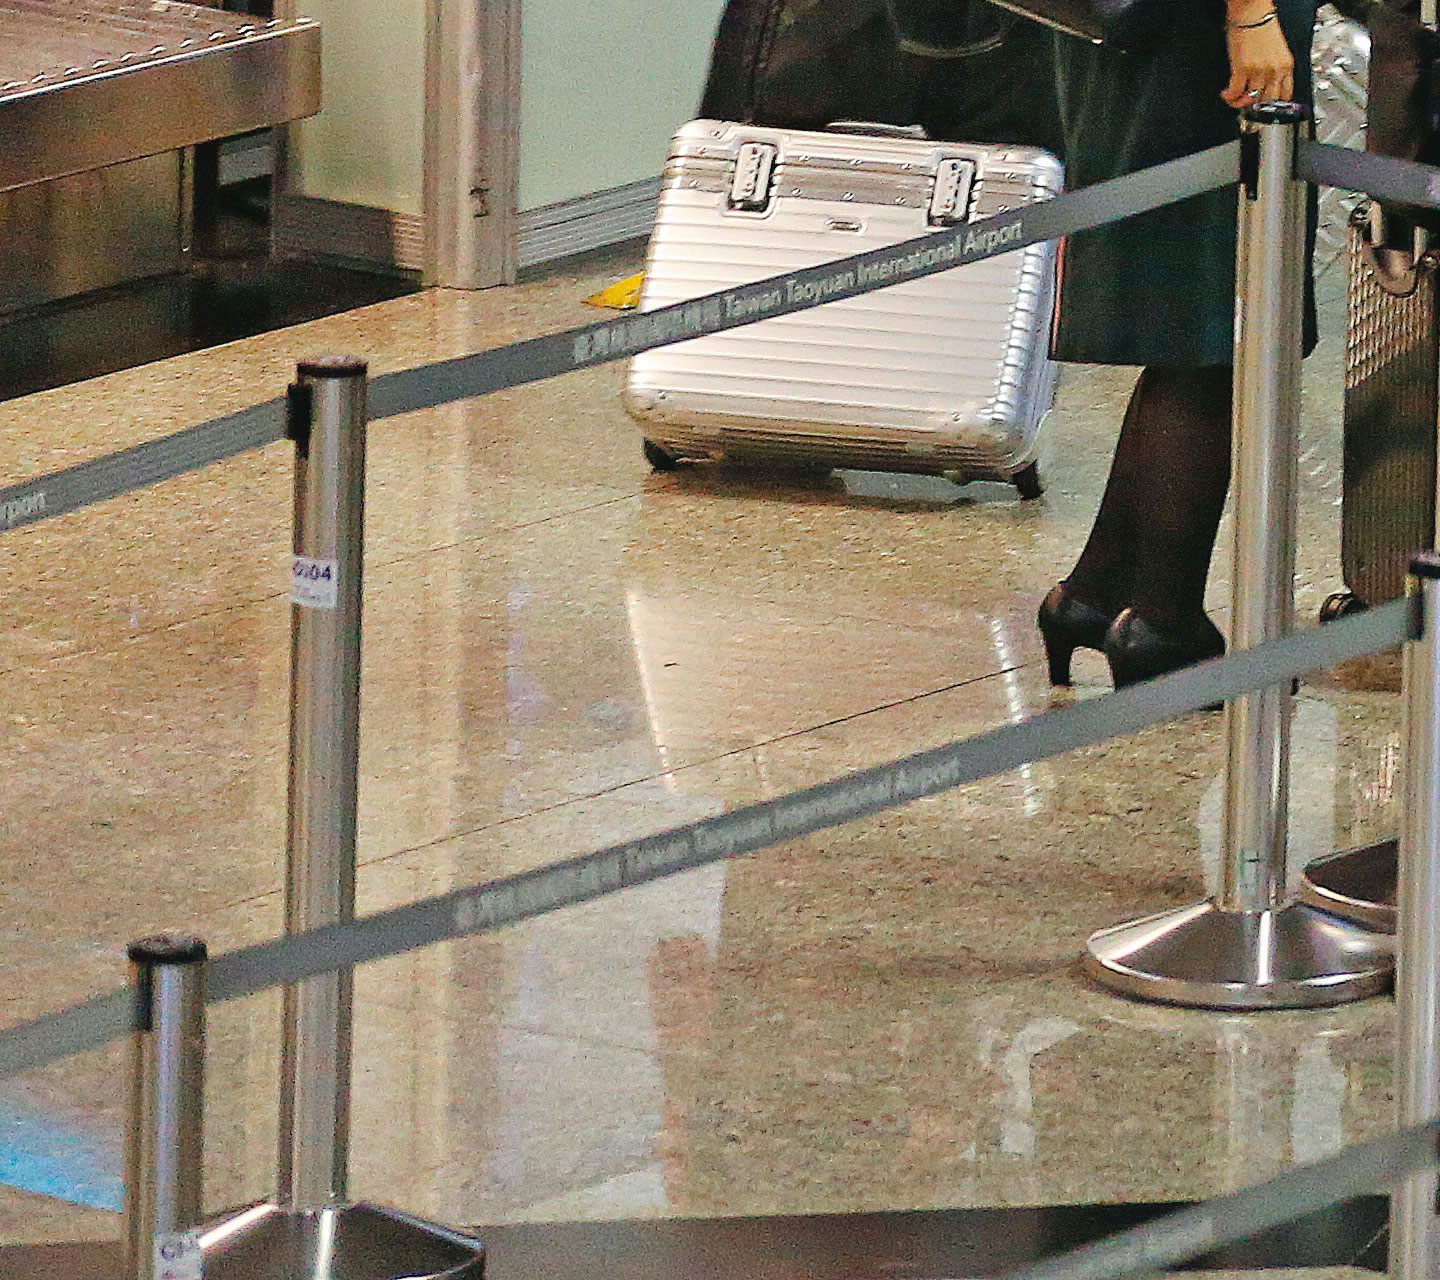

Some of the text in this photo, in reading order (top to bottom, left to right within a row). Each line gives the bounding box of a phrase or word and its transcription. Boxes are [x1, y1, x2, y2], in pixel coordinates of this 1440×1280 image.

[724, 221, 1025, 318] Taiwan Taoyuan International Airport
